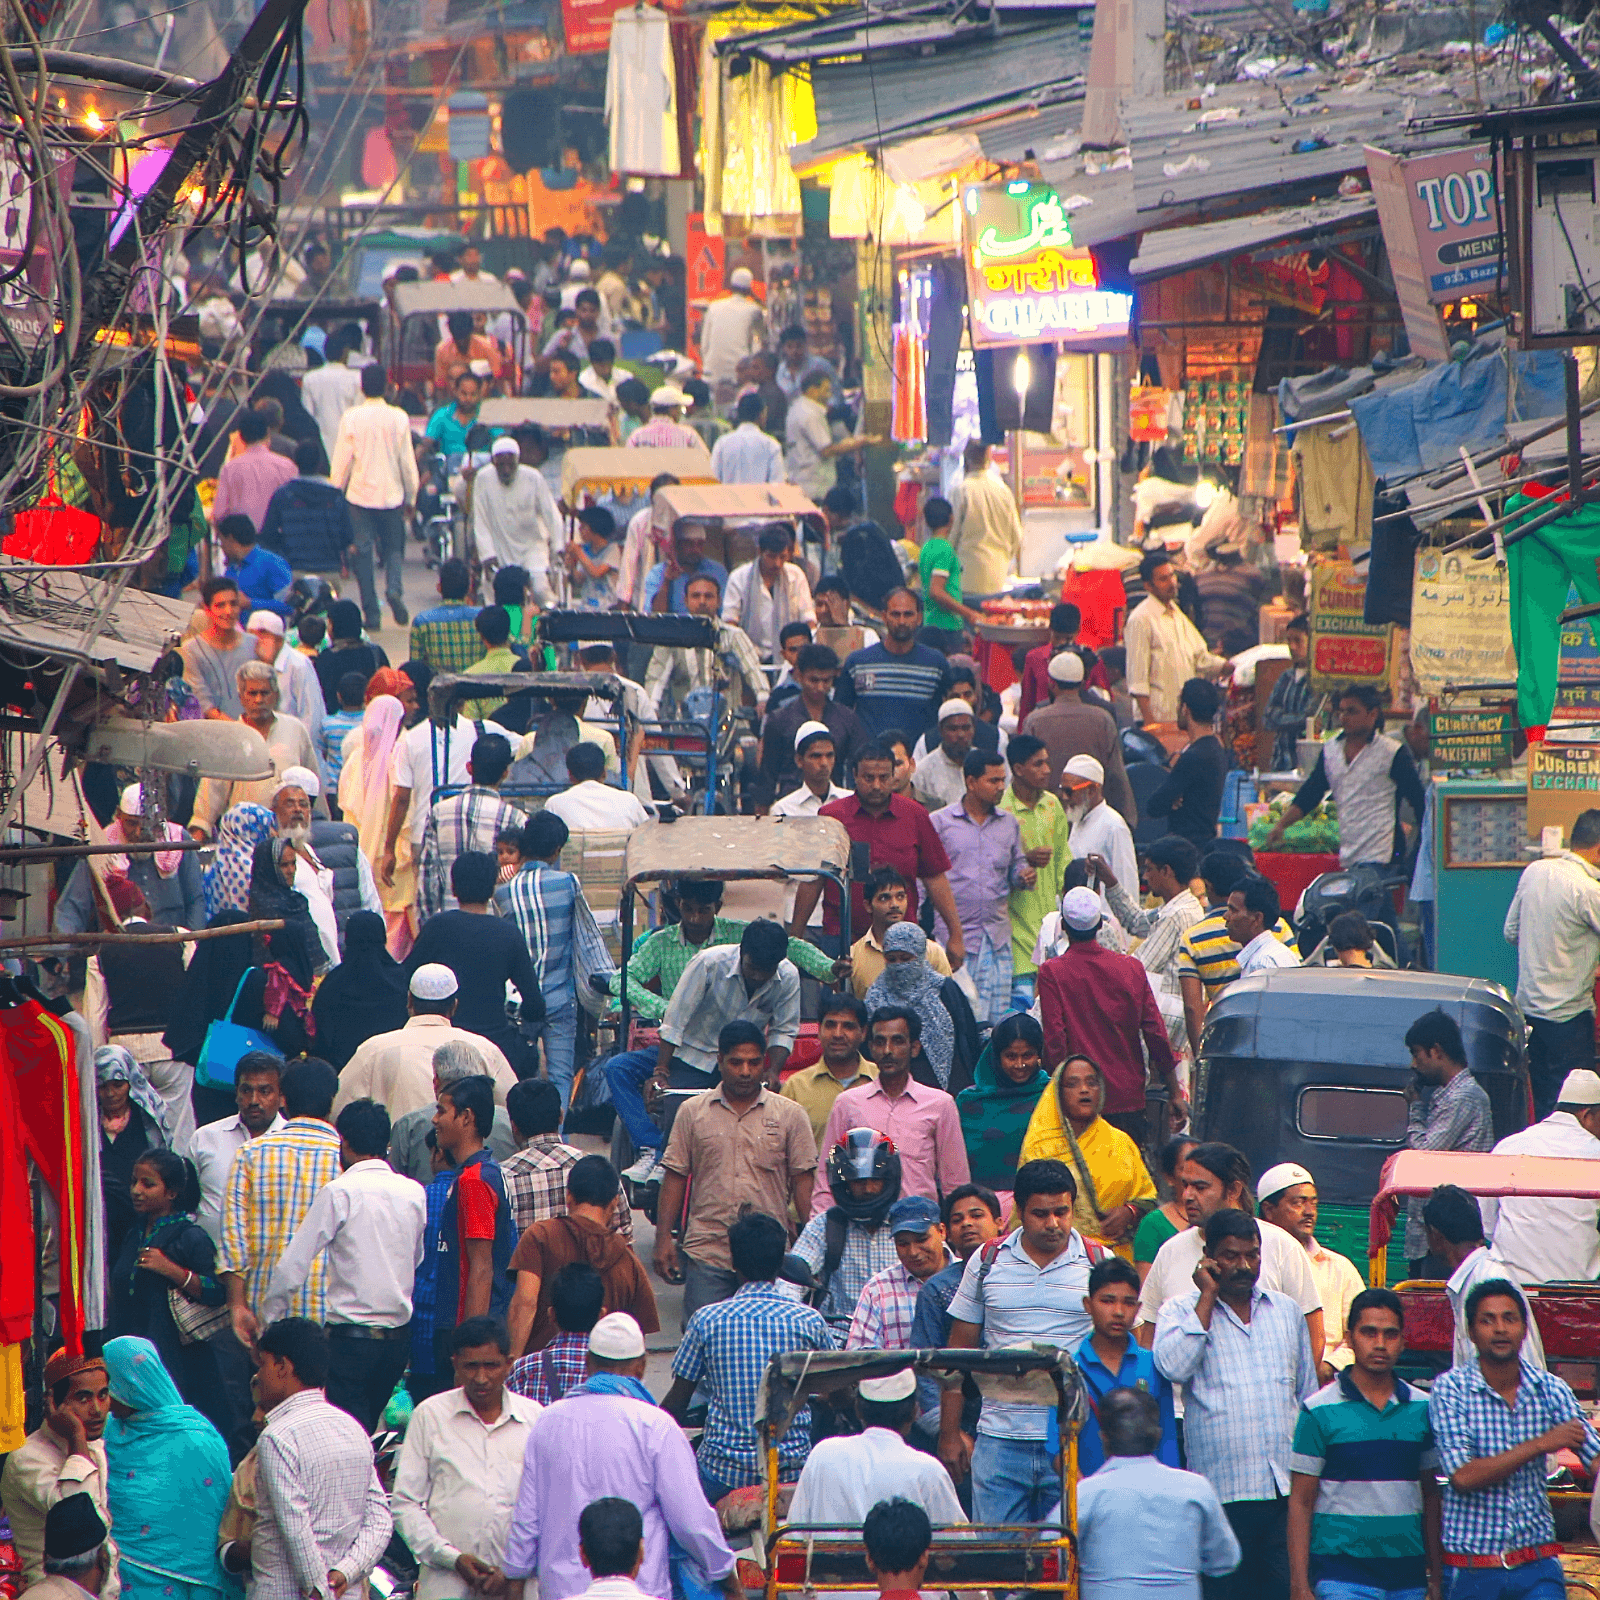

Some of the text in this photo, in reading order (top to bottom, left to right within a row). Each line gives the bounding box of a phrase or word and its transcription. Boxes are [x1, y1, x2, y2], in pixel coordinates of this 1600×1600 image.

[1416, 168, 1494, 231] TOP
[1436, 715, 1503, 732] CURRENCY
[1434, 746, 1492, 763] PAKISTANI
[1565, 748, 1591, 760] OLD
